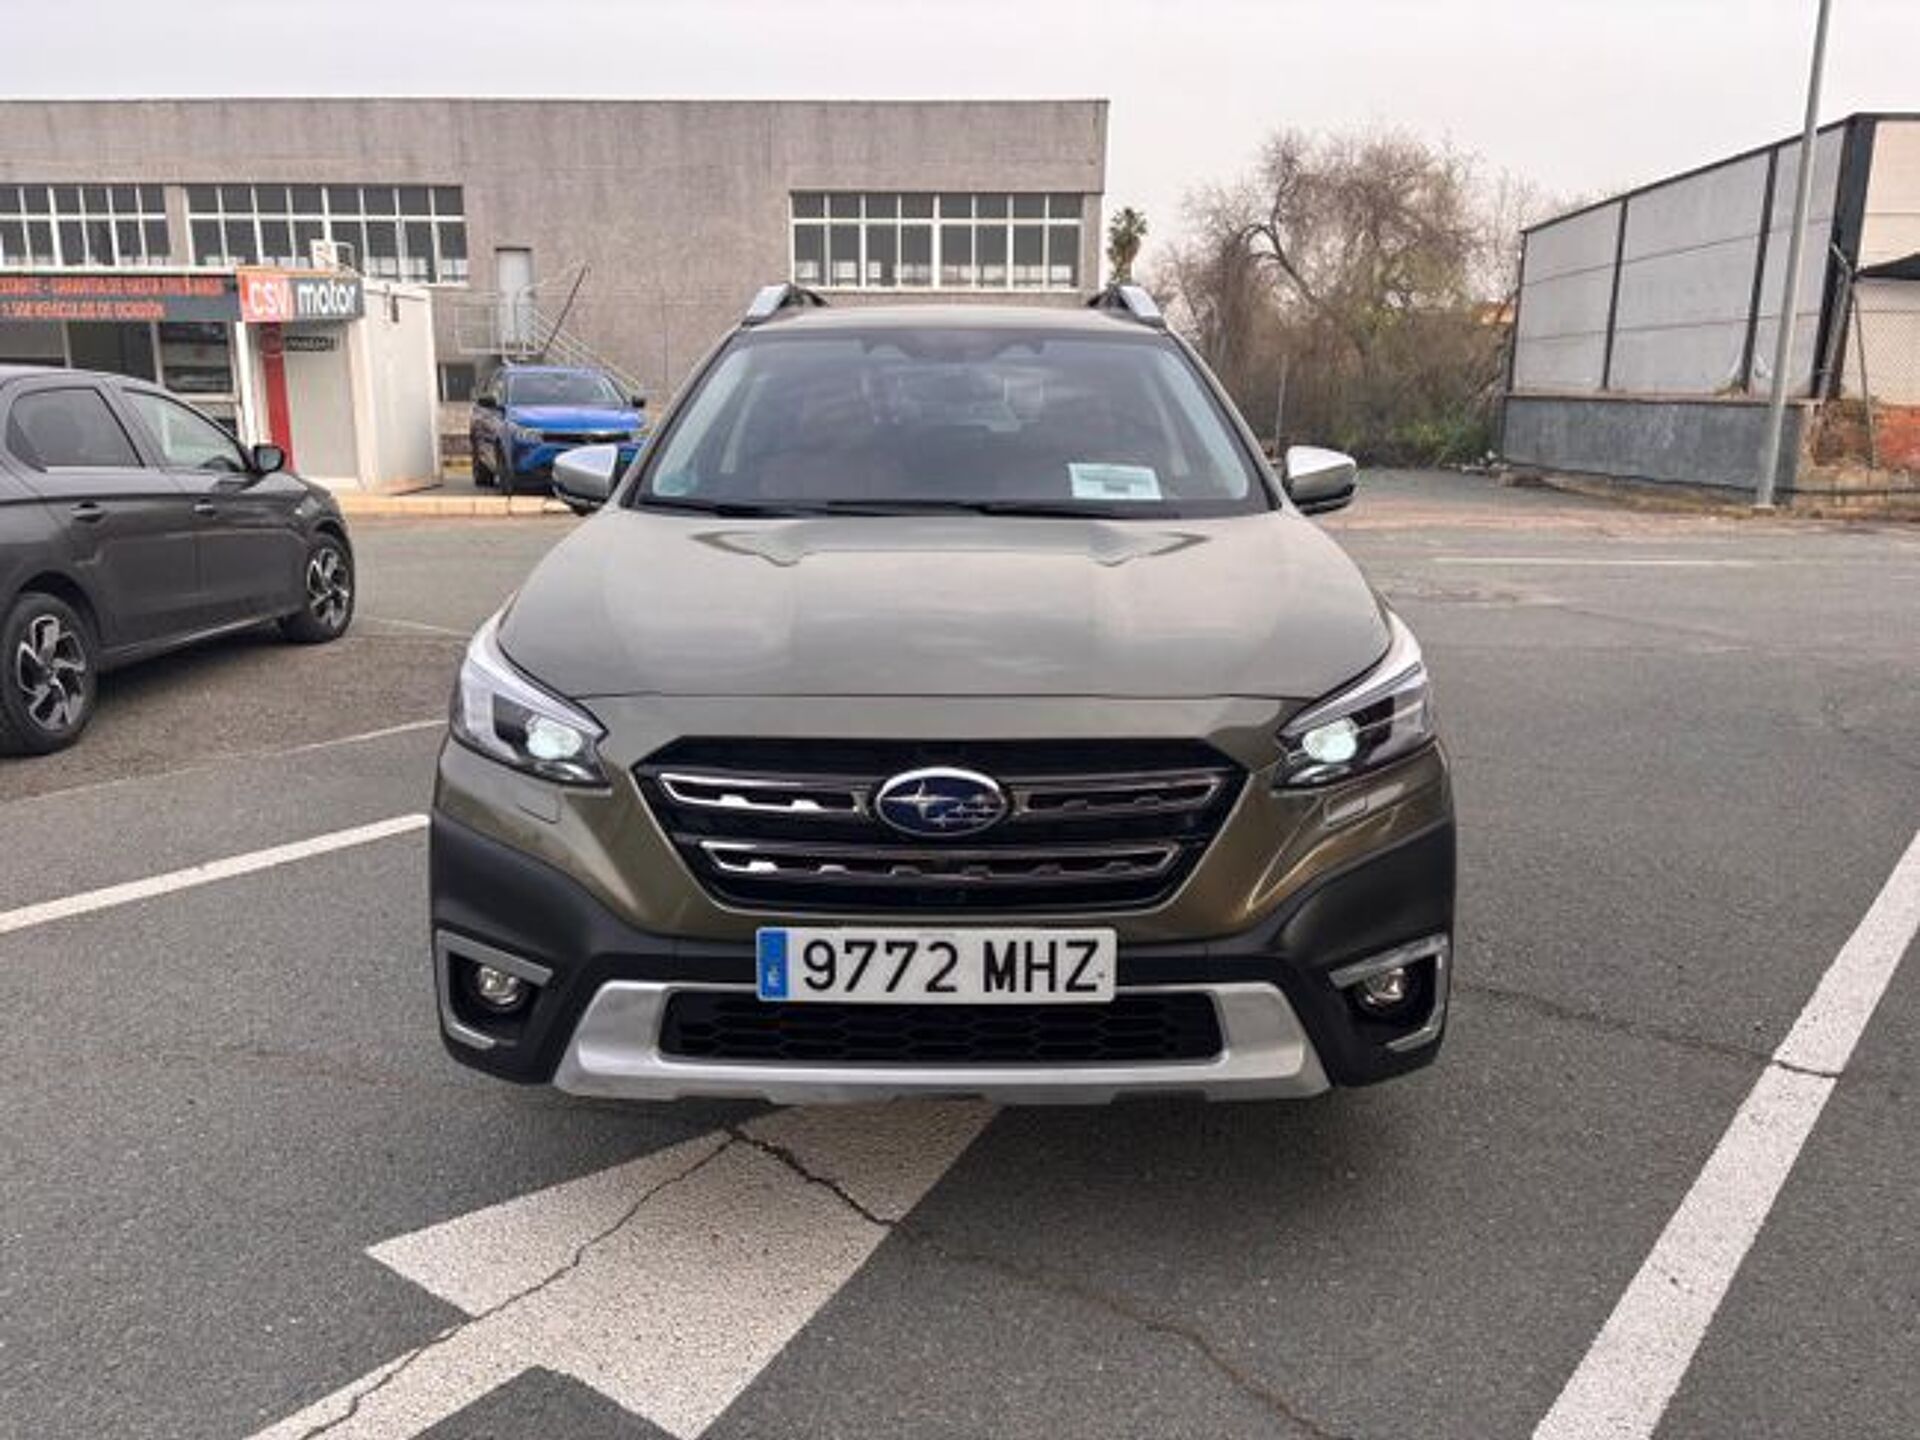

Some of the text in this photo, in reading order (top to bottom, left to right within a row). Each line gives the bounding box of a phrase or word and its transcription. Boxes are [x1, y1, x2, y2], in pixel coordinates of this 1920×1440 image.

[249, 281, 290, 314] csv
[297, 279, 357, 315] motor
[803, 939, 1098, 993] 9772 MHZ
